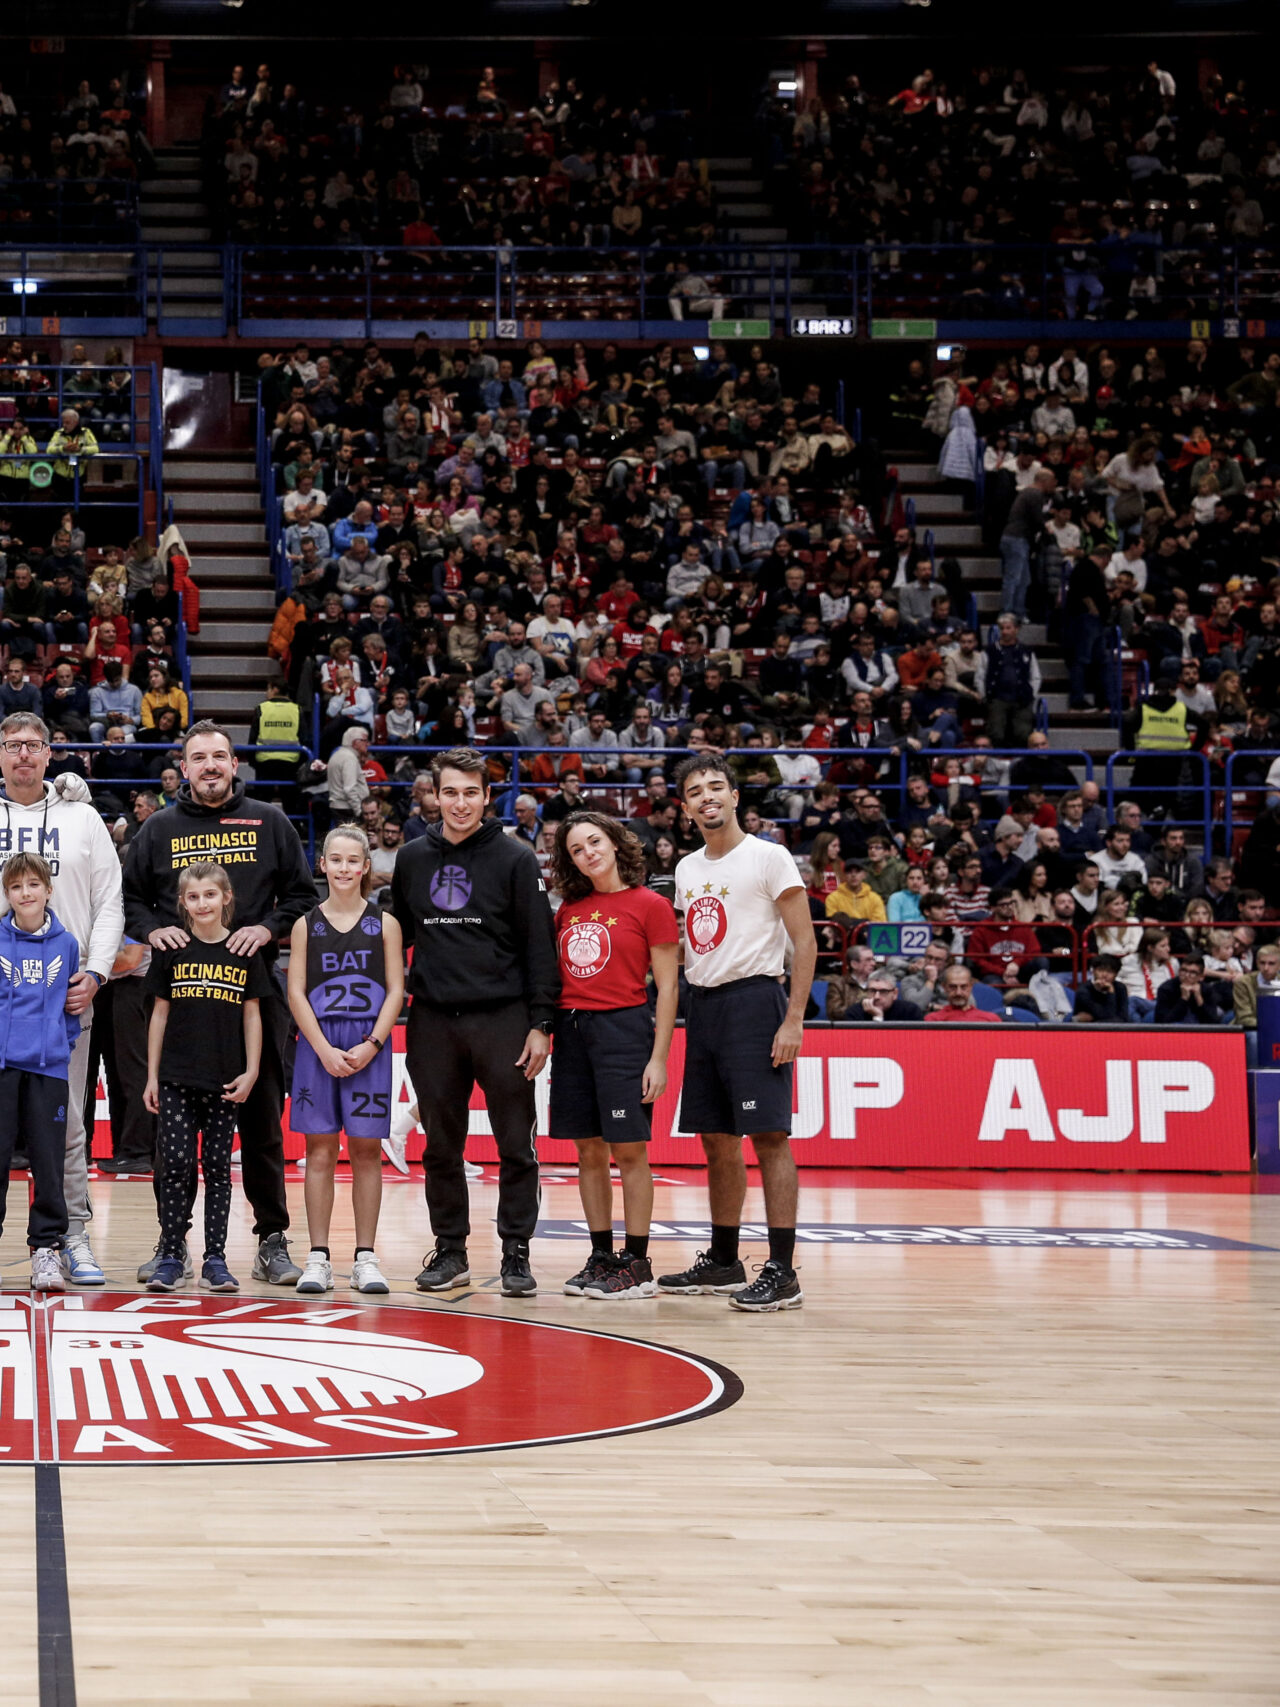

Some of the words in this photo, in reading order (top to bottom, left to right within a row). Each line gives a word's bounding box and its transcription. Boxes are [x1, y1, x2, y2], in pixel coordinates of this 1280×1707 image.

[501, 323, 515, 334] 22
[808, 320, 842, 335] BAR
[171, 831, 257, 853] BUCCINASCO
[692, 898, 720, 911] OLIMPIA
[572, 924, 603, 936] OLIMPIA
[875, 930, 894, 949] A
[904, 931, 927, 948] 22
[23, 959, 43, 970] BFM
[321, 950, 372, 972] BAT
[173, 963, 248, 986] UCCINASCO
[571, 964, 596, 975] MILANO
[172, 986, 242, 1005] BASKETBALL
[324, 982, 372, 1012] 25
[350, 1092, 389, 1118] 25
[742, 1100, 756, 1109] EA7
[978, 1058, 1215, 1144] AJP
[612, 1109, 626, 1118] EA7
[68, 1339, 144, 1349] 36
